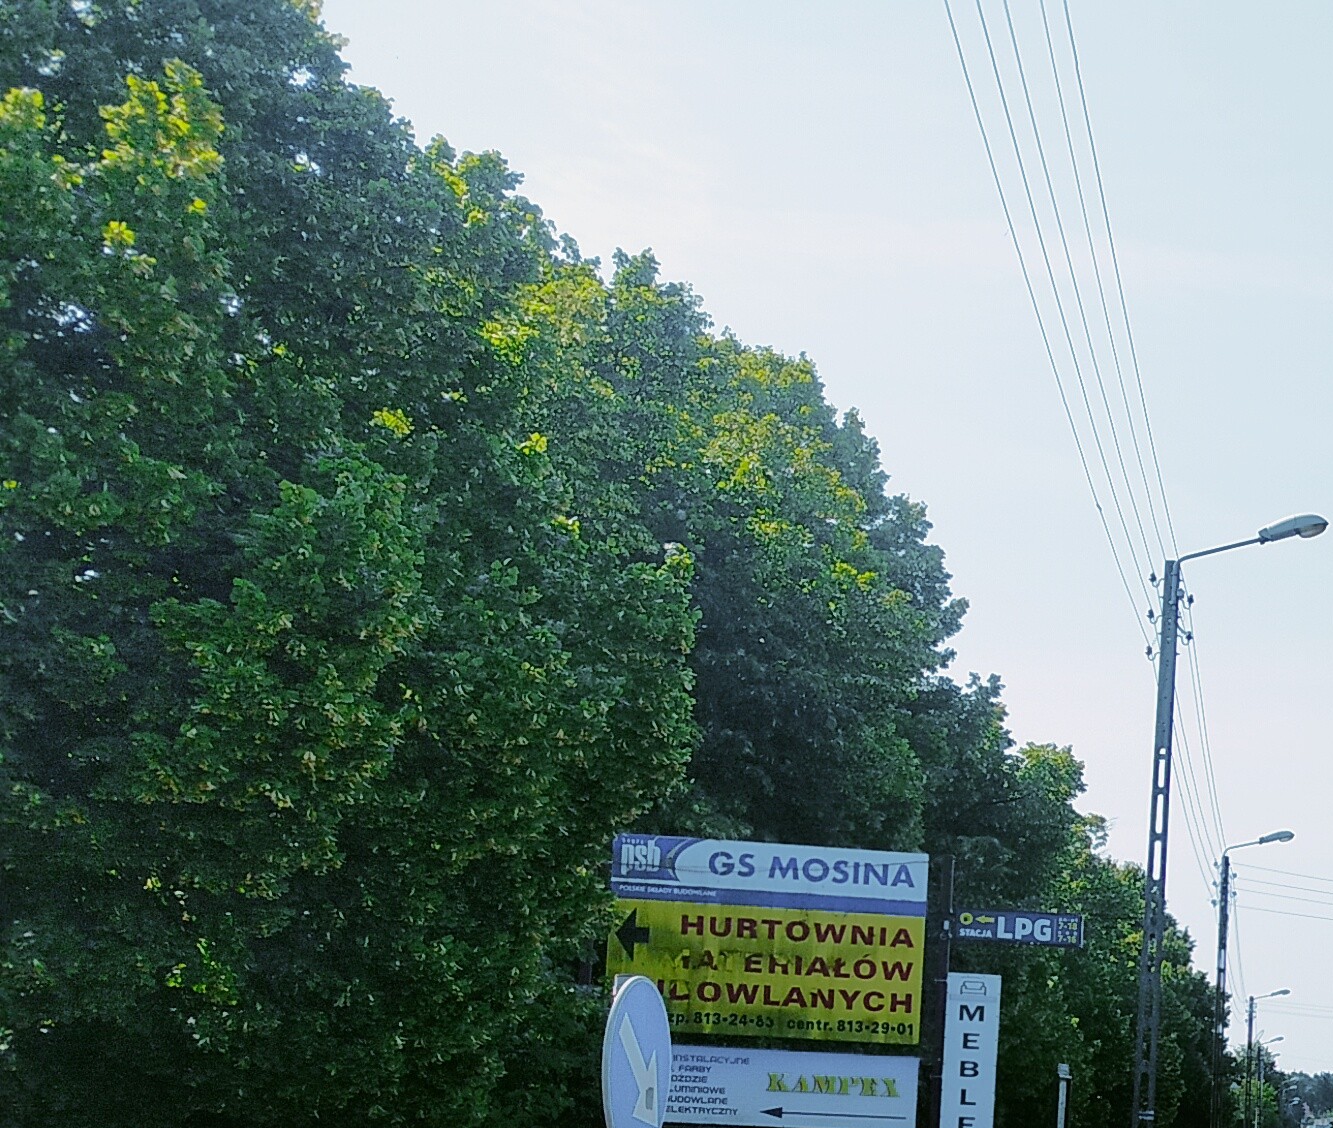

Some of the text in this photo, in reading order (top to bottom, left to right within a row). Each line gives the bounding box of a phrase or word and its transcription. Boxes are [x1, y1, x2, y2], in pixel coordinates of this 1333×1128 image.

[621, 839, 661, 876] psb
[708, 851, 915, 888] GS MOSINA
[680, 914, 914, 948] HURTOWNIA
[960, 916, 1052, 941] STACJA LPG
[836, 1019, 914, 1036] 813-29-01
